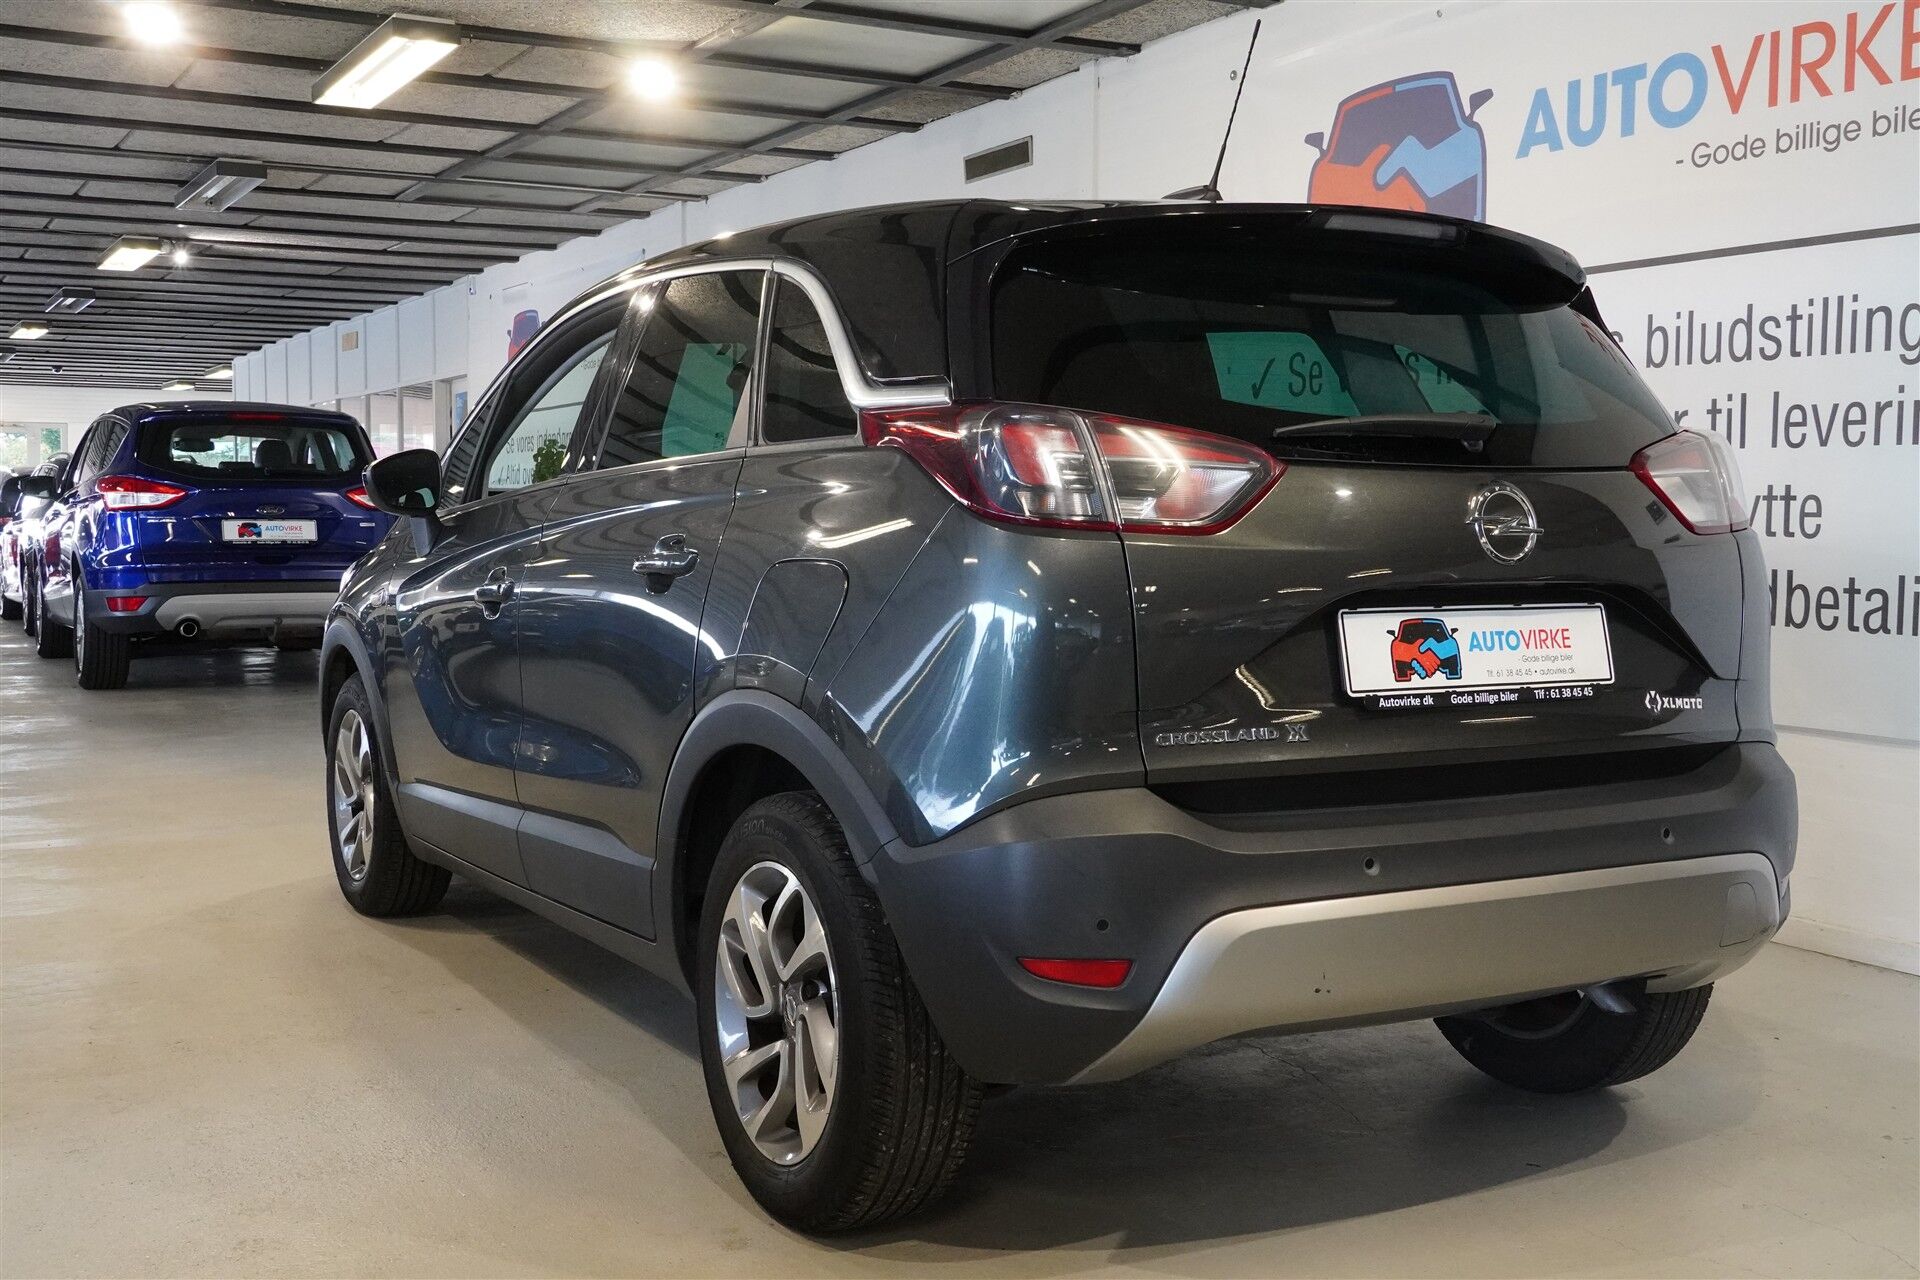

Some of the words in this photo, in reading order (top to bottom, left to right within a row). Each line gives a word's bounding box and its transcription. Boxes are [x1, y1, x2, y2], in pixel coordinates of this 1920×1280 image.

[1515, 0, 1920, 160] AUTOVIRKE
[1691, 133, 1767, 169] Gode
[1775, 121, 1862, 153] billige
[1645, 293, 1920, 369] biludstilling
[1288, 352, 1323, 397] Se
[1706, 392, 1747, 449] til
[1469, 628, 1572, 652] AUTOVIRKE
[1522, 655, 1540, 663] Gode
[1496, 669, 1504, 678] 61
[1506, 668, 1514, 677] 38
[1515, 668, 1523, 677] 45
[1524, 667, 1533, 676] 45
[1450, 693, 1473, 704] Gode
[1474, 691, 1499, 705] billige
[1500, 690, 1519, 703] biler
[1550, 689, 1561, 699] 61
[1562, 688, 1572, 698] 38
[1572, 687, 1582, 697] 45
[1583, 687, 1593, 697] 45
[1662, 697, 1703, 709] XLMOTO
[1156, 727, 1280, 747] CROSSLAND
[1285, 724, 1310, 742] X
